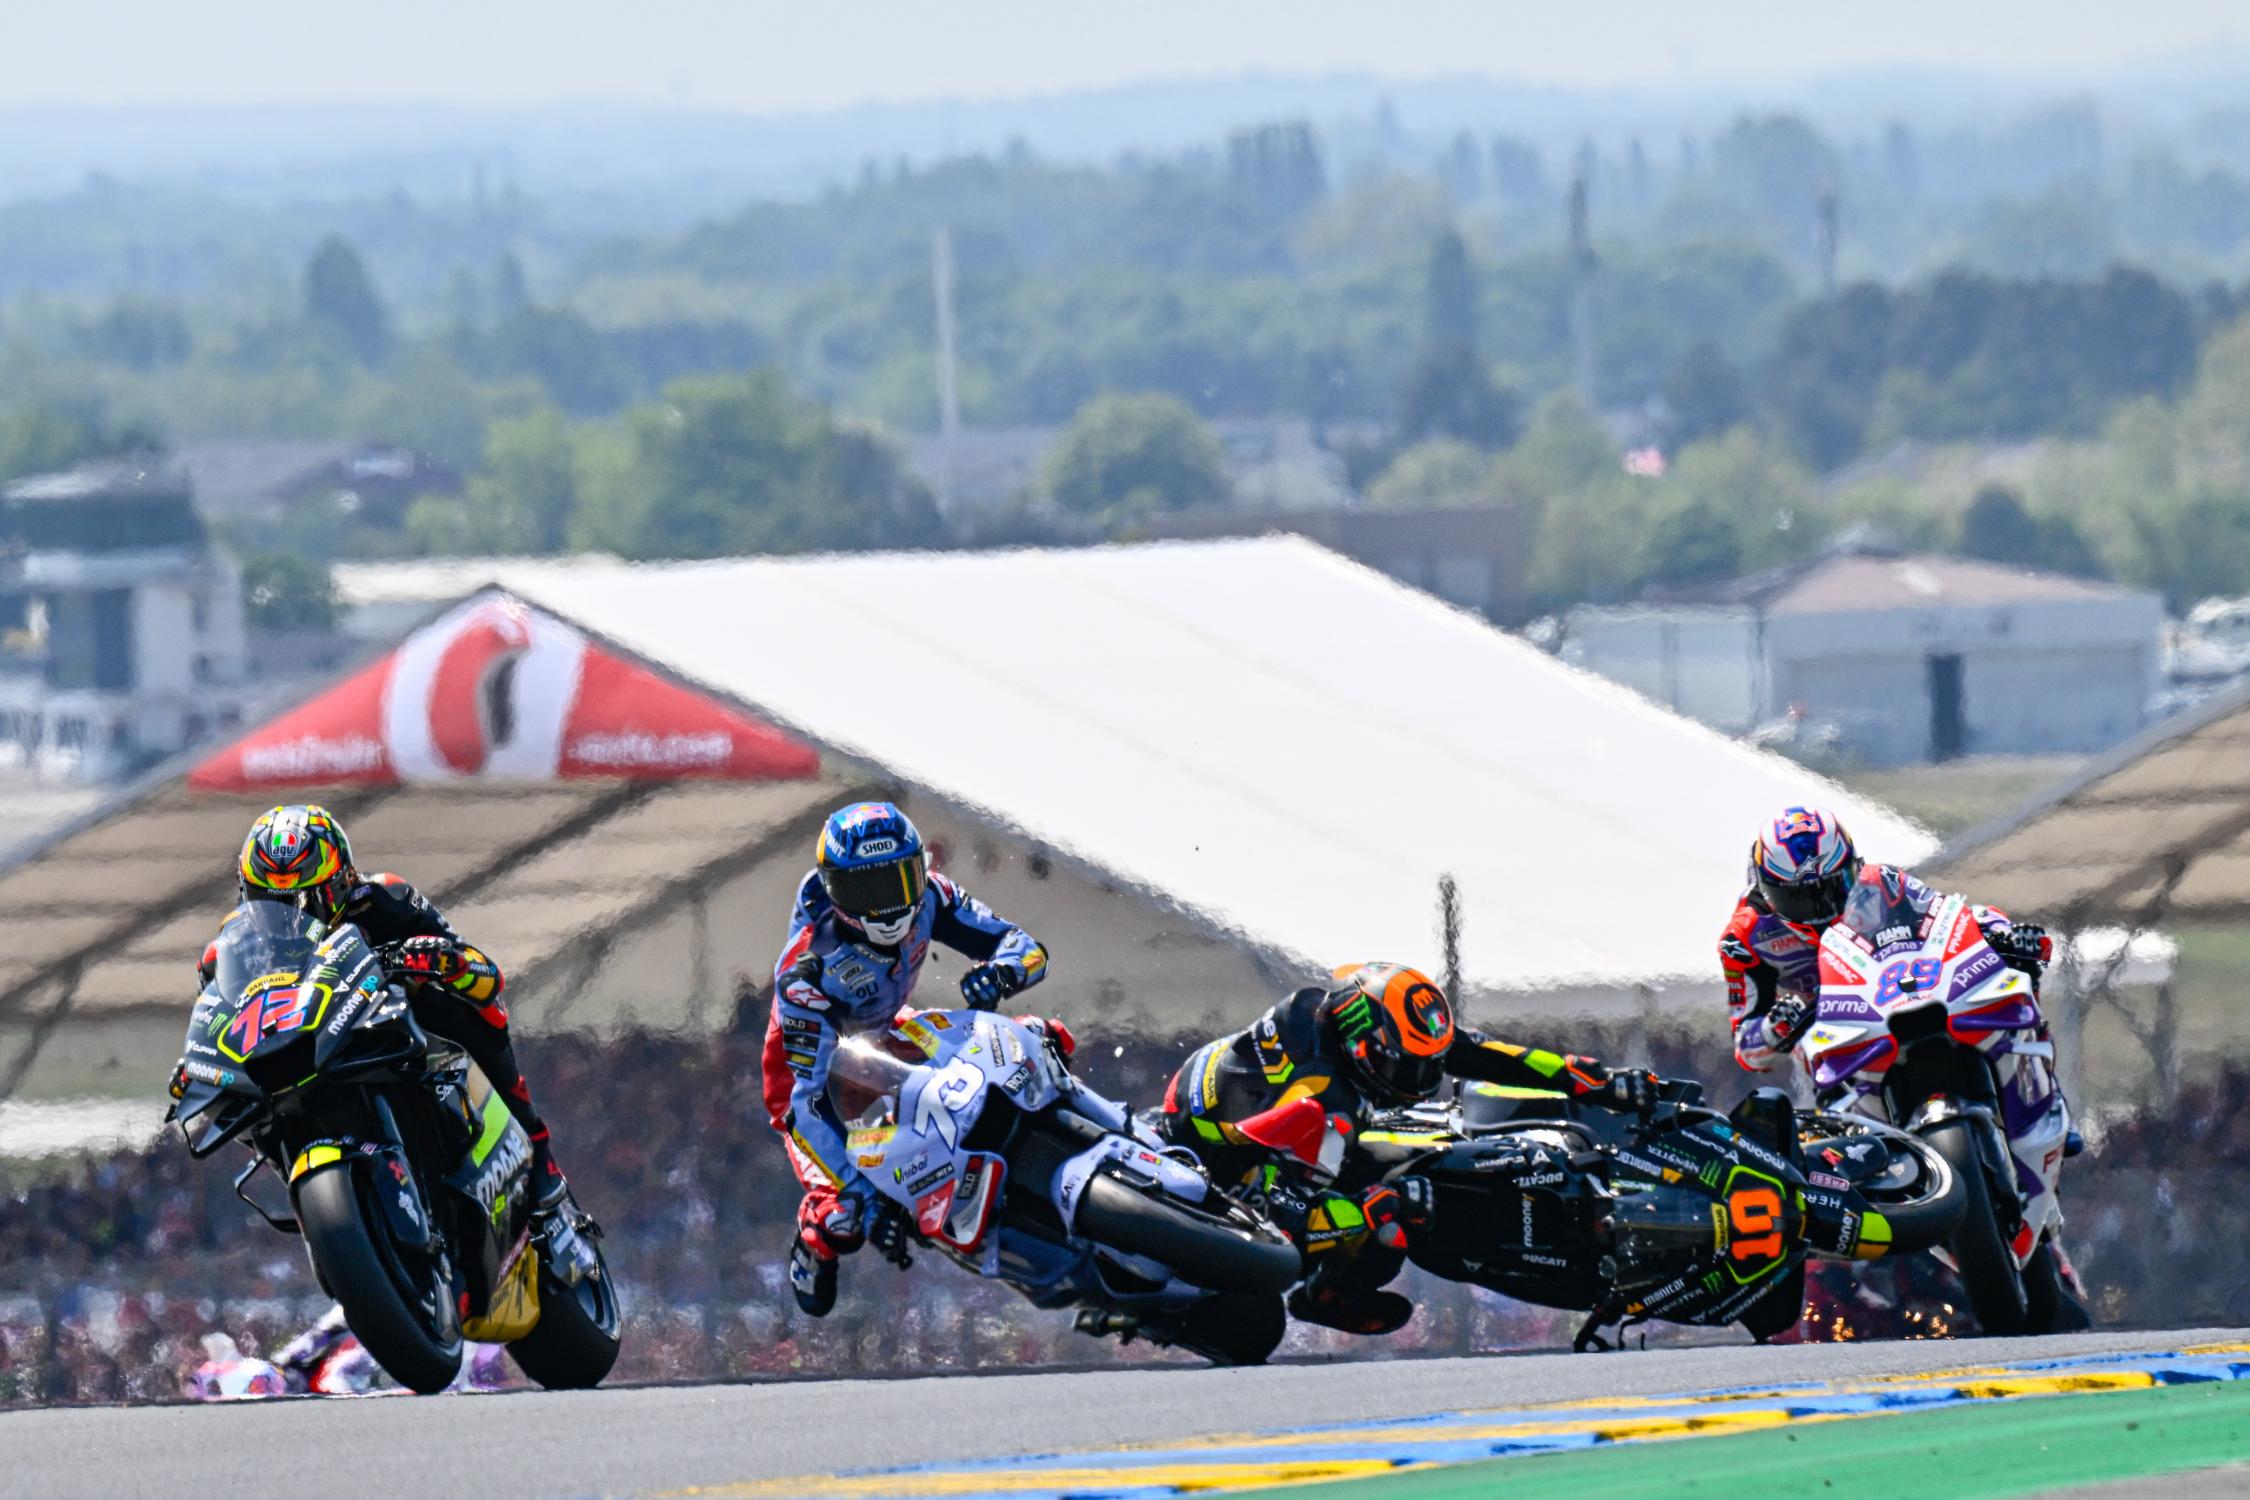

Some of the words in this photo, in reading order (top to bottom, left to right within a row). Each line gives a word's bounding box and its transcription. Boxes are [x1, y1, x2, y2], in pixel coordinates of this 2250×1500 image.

[272, 845, 297, 856] agv
[863, 841, 893, 855] SHOEI
[1875, 925, 1913, 947] FIAMM
[1874, 957, 1943, 1007] 89
[1953, 952, 2000, 987] prima
[328, 975, 379, 1036] mooneygo
[1818, 1000, 1868, 1017] prima
[230, 986, 307, 1055] 72
[1005, 1066, 1031, 1092] BOLD
[912, 1055, 984, 1155] 73
[1518, 1172, 1564, 1187] DUCATI
[1812, 1174, 1847, 1188] FASSI
[1729, 1187, 1783, 1262] 10
